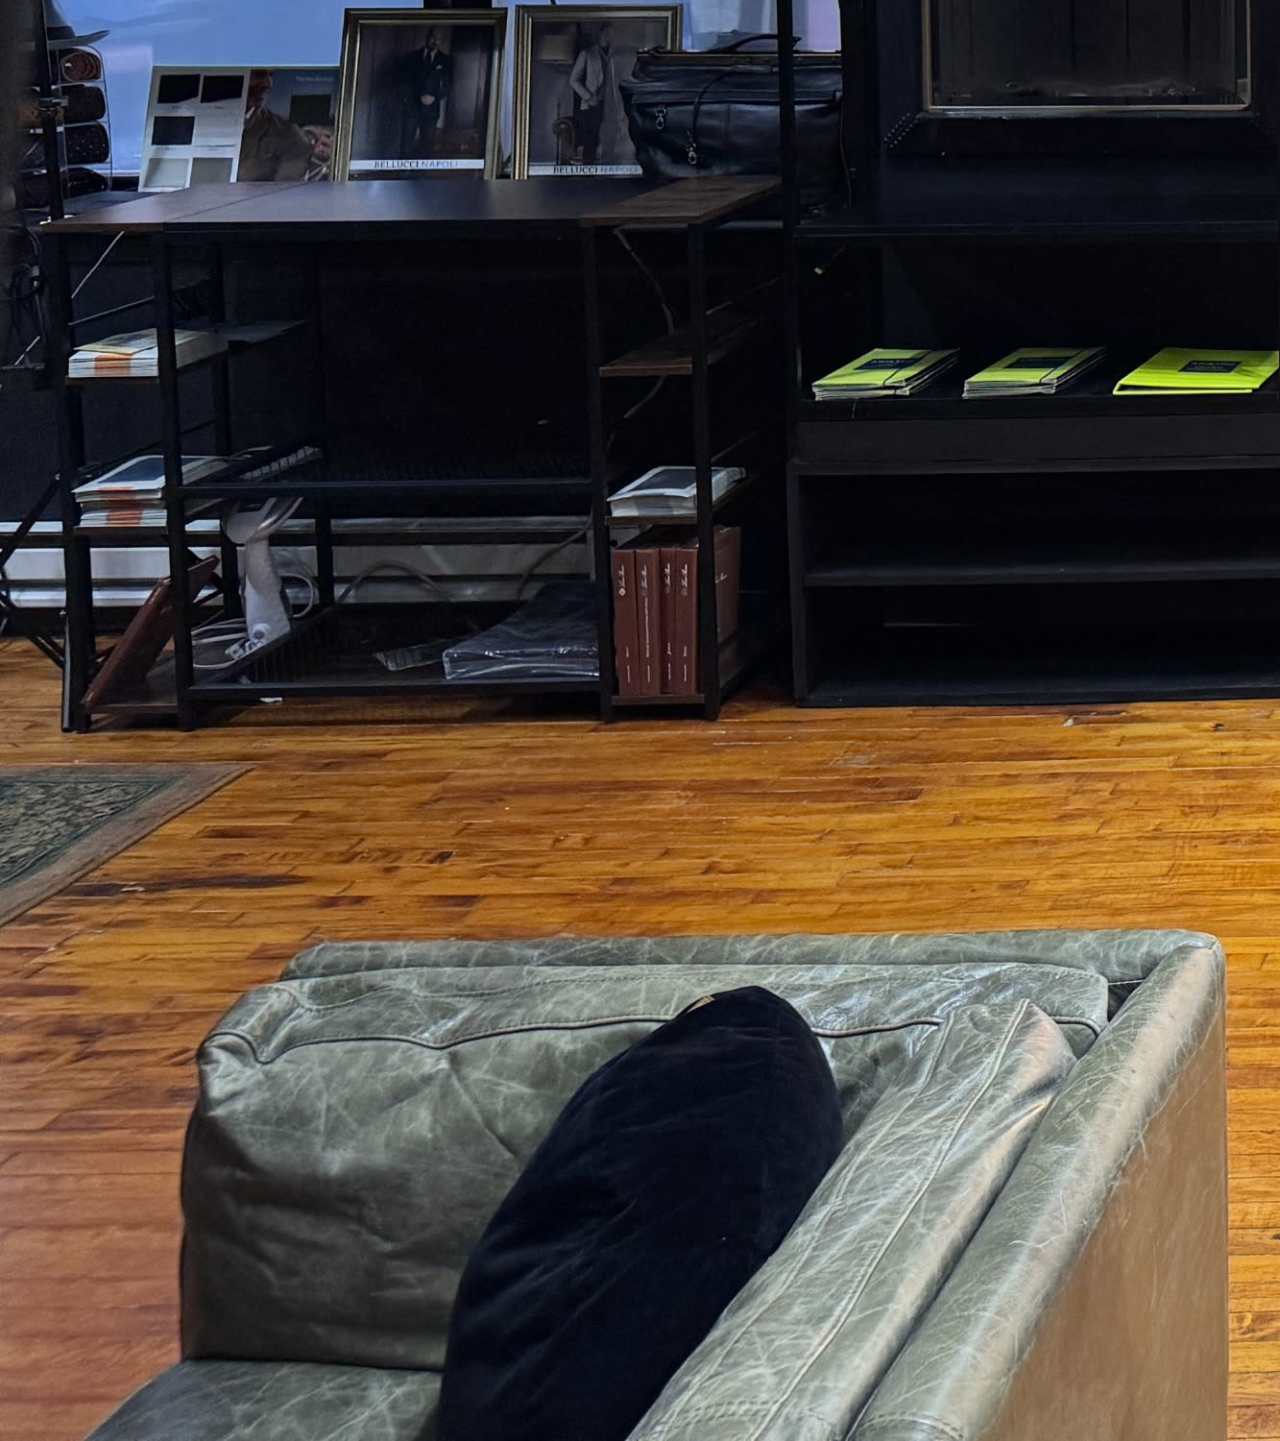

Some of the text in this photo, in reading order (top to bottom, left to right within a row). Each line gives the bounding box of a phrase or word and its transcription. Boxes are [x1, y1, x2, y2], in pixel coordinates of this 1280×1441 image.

[374, 159, 459, 169] BELLUCCI NAPOLI
[553, 165, 598, 174] BELLUCCI
